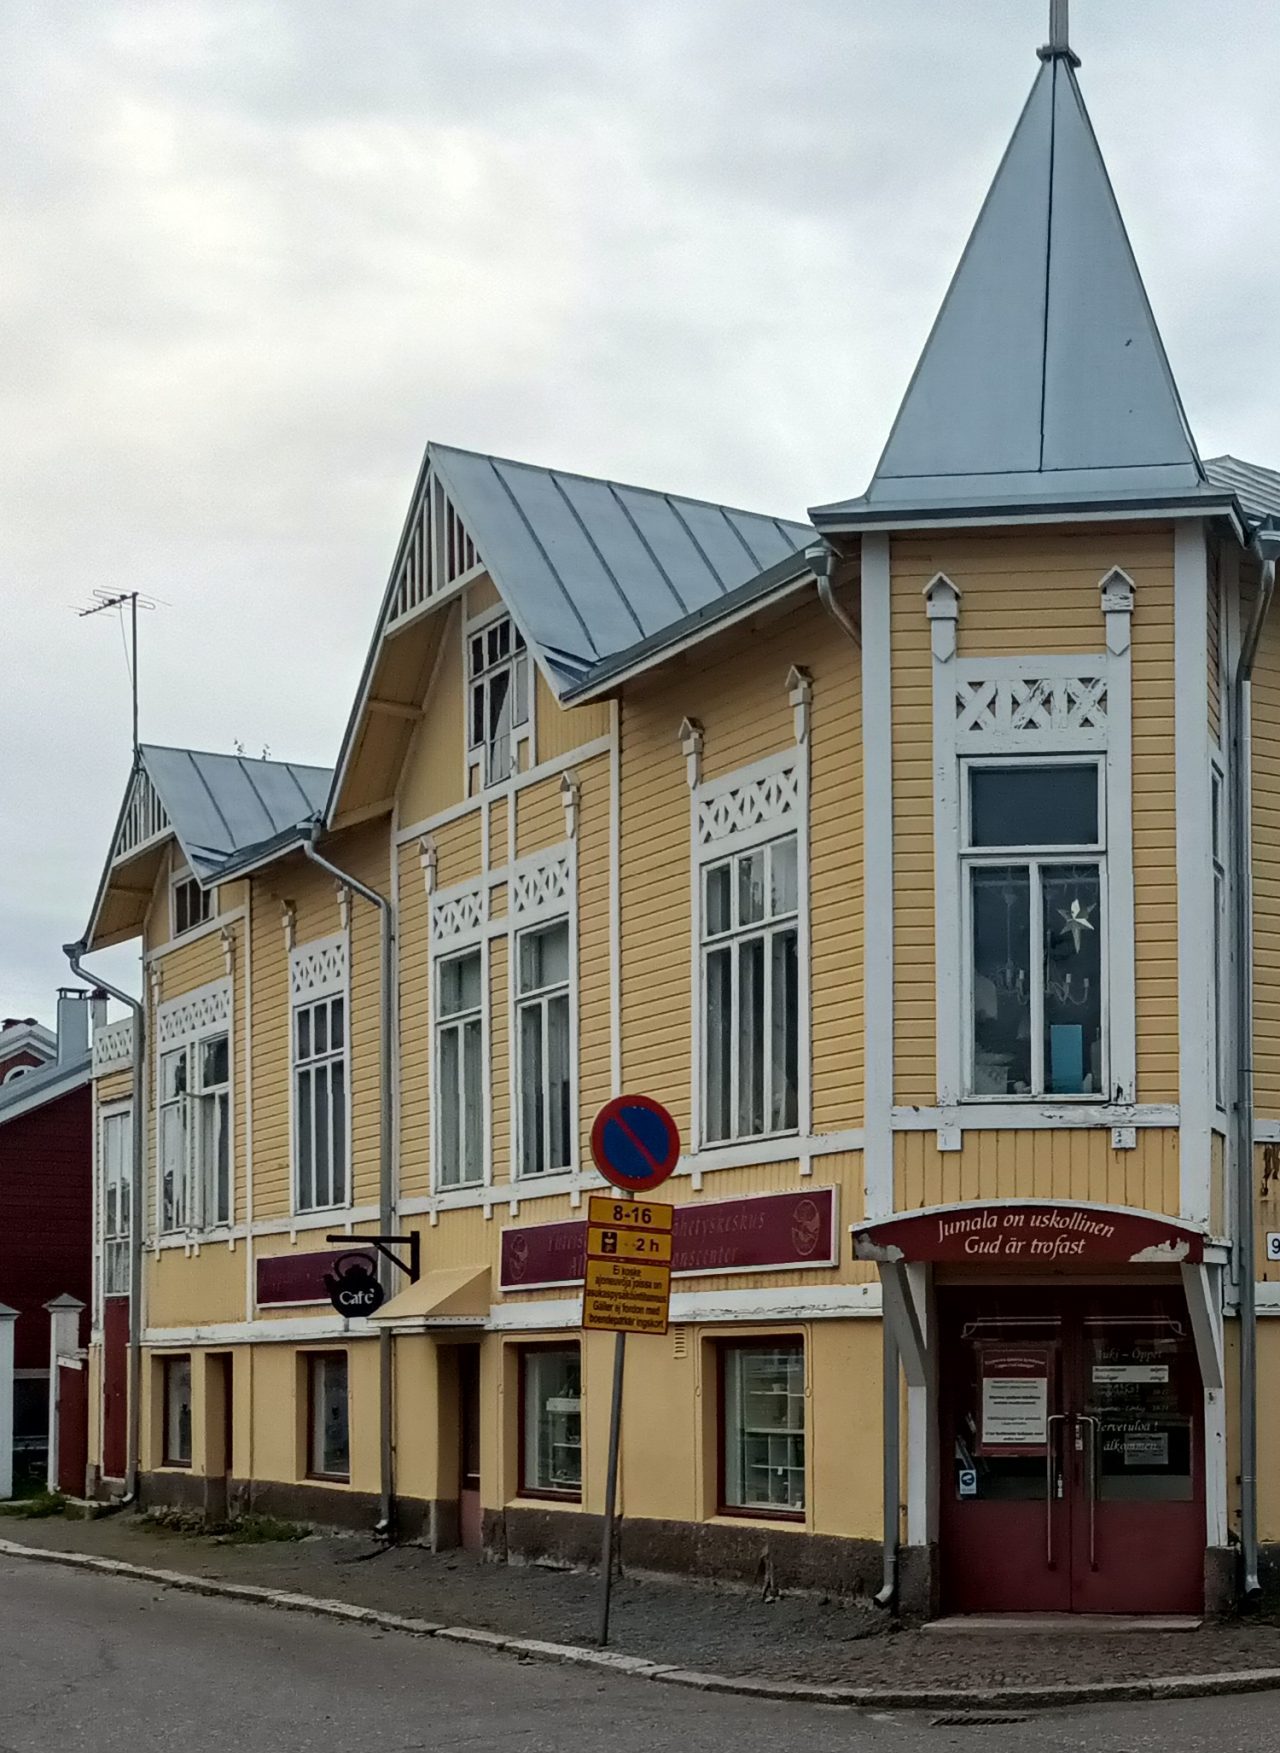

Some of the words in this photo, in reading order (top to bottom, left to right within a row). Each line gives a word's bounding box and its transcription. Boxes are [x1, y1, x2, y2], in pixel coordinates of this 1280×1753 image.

[613, 1205, 652, 1224] 8-16
[937, 1210, 998, 1243] Jumala
[1003, 1213, 1025, 1228] on
[1030, 1209, 1115, 1238] uskollinen
[635, 1238, 645, 1252] 2
[650, 1239, 660, 1253] h
[964, 1235, 1003, 1254] Gud
[1005, 1237, 1026, 1254] är
[1030, 1234, 1086, 1261] trofast
[1272, 1238, 1280, 1254] 9
